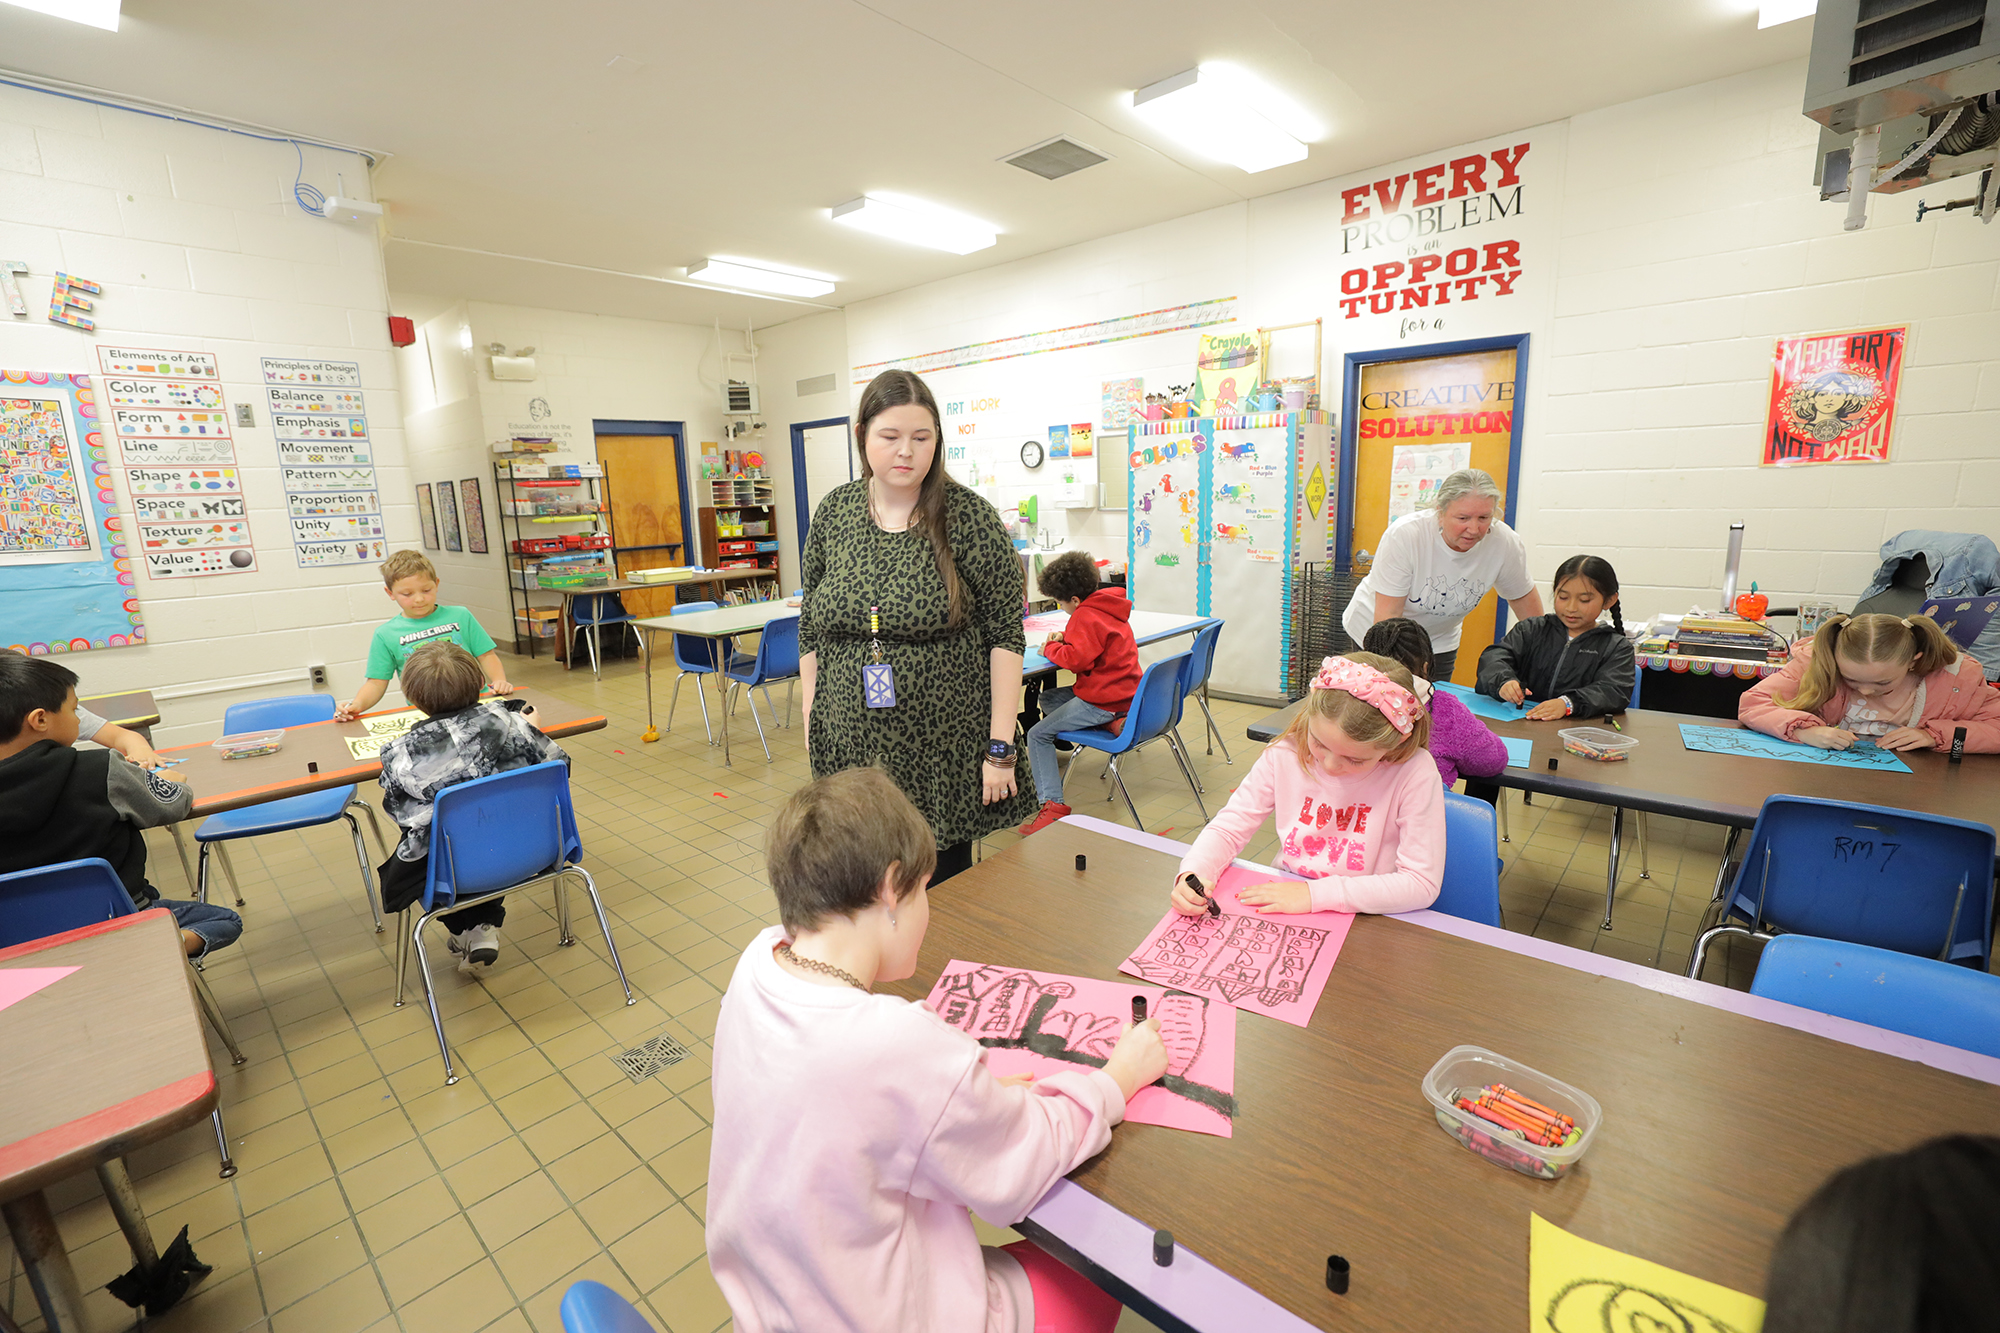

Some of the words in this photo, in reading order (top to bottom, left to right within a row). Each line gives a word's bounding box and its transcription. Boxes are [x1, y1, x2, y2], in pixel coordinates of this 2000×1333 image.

[1341, 142, 1530, 226] EVERY
[1341, 184, 1526, 255] PROBLEM
[1407, 243, 1418, 256] is
[1424, 238, 1442, 252] an
[1341, 239, 1521, 295] OPPOR
[1340, 269, 1522, 319] TUNITY
[1400, 318, 1428, 339] for
[1434, 318, 1445, 330] a
[1210, 333, 1250, 350] Crayola
[109, 350, 167, 361] Elements
[187, 355, 206, 364] Art
[1778, 337, 1848, 391] MAKE
[1851, 332, 1902, 381] ART
[264, 360, 310, 371] Principles
[325, 364, 356, 374] Design
[110, 382, 156, 393] Color
[271, 390, 324, 402] Balance
[1362, 382, 1515, 410] CREATIVE
[946, 402, 964, 415] ART
[971, 398, 1000, 412] WORK
[117, 412, 162, 422] Form
[276, 417, 340, 429] Emphasis
[958, 424, 976, 435] NOT
[1360, 410, 1513, 439] SOLUTION
[1771, 420, 1821, 460] NOT
[1823, 408, 1888, 459] WAR
[124, 441, 158, 451] Line
[281, 443, 354, 453] Movement
[1130, 434, 1206, 468] COLORS
[948, 447, 966, 460] ART
[130, 470, 181, 483] Shape
[286, 470, 337, 479] Pattern
[137, 499, 185, 511] Space
[290, 494, 363, 506] Proportion
[142, 526, 203, 537] Texture
[295, 520, 330, 531] Unity
[298, 544, 346, 555] Variety
[149, 554, 194, 565] Value
[400, 623, 460, 646] MINECRAFT
[1299, 796, 1372, 834] LOVE
[1834, 837, 1873, 862] RM
[1880, 843, 1902, 872] 7
